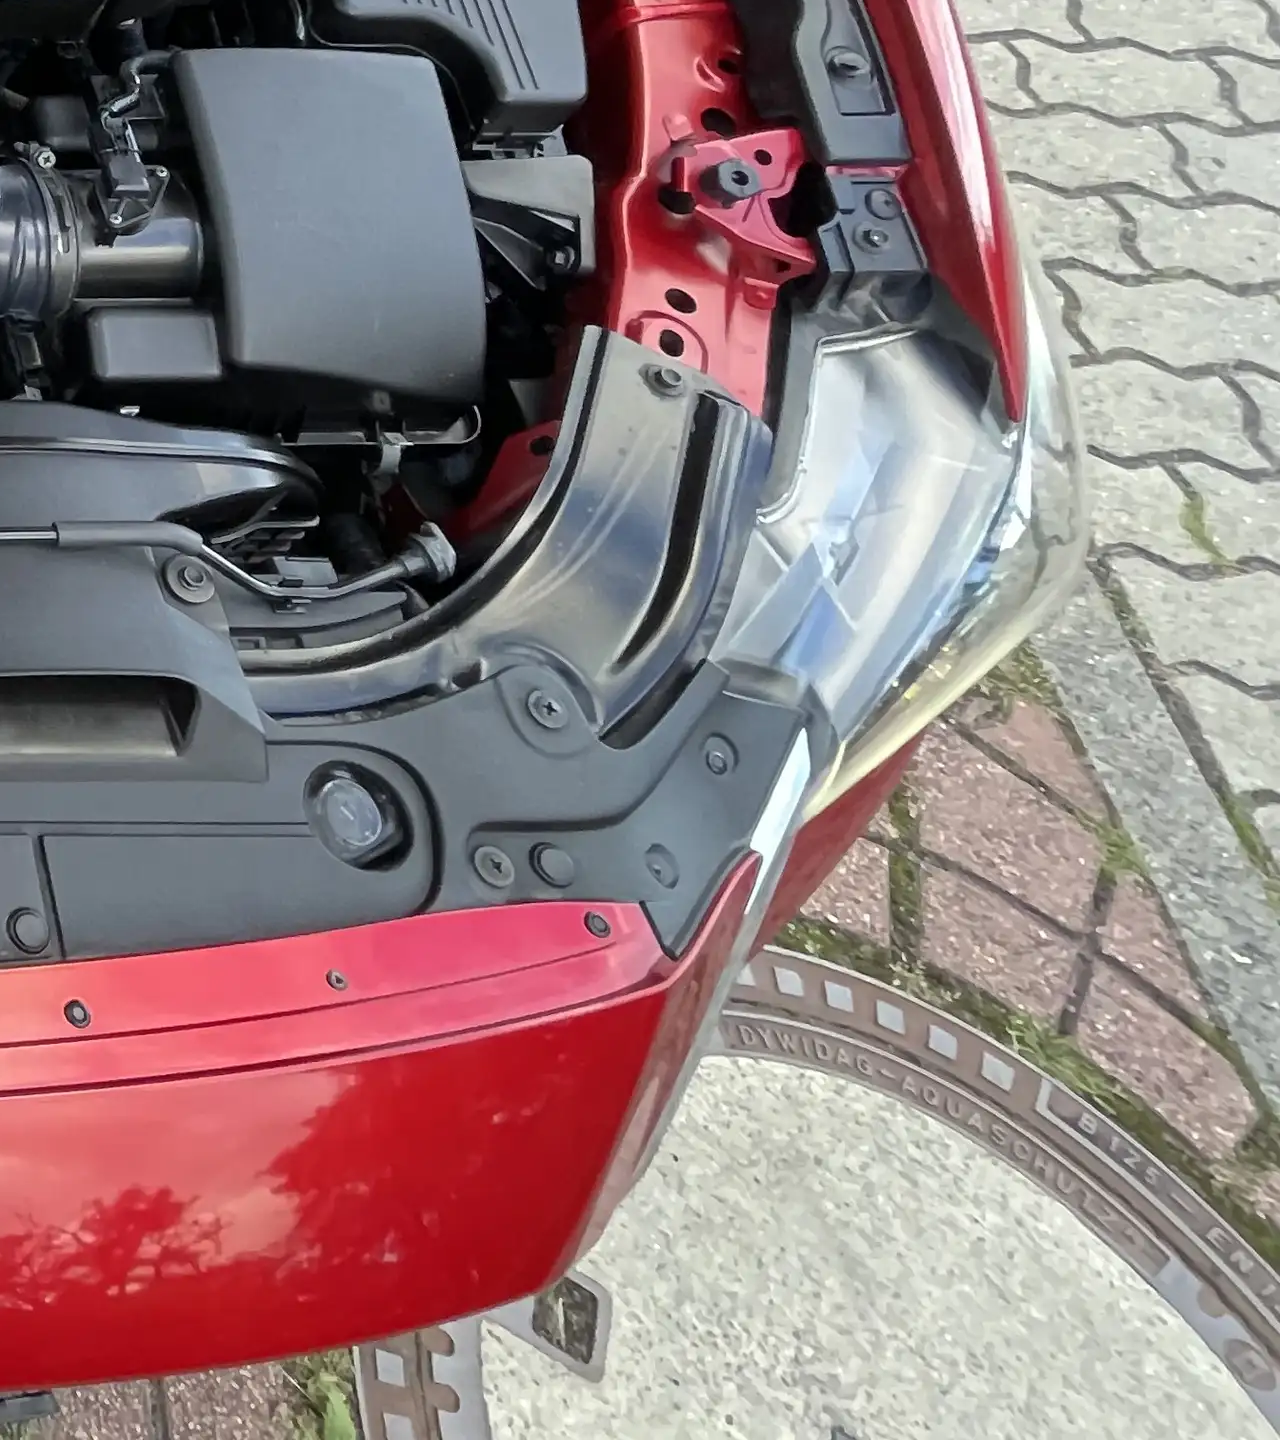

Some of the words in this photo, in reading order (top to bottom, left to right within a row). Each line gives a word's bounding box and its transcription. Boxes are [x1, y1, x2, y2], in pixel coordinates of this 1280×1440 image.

[1077, 1112, 1098, 1136] B
[1108, 1136, 1164, 1187] 125
[1205, 1227, 1255, 1274] EN
